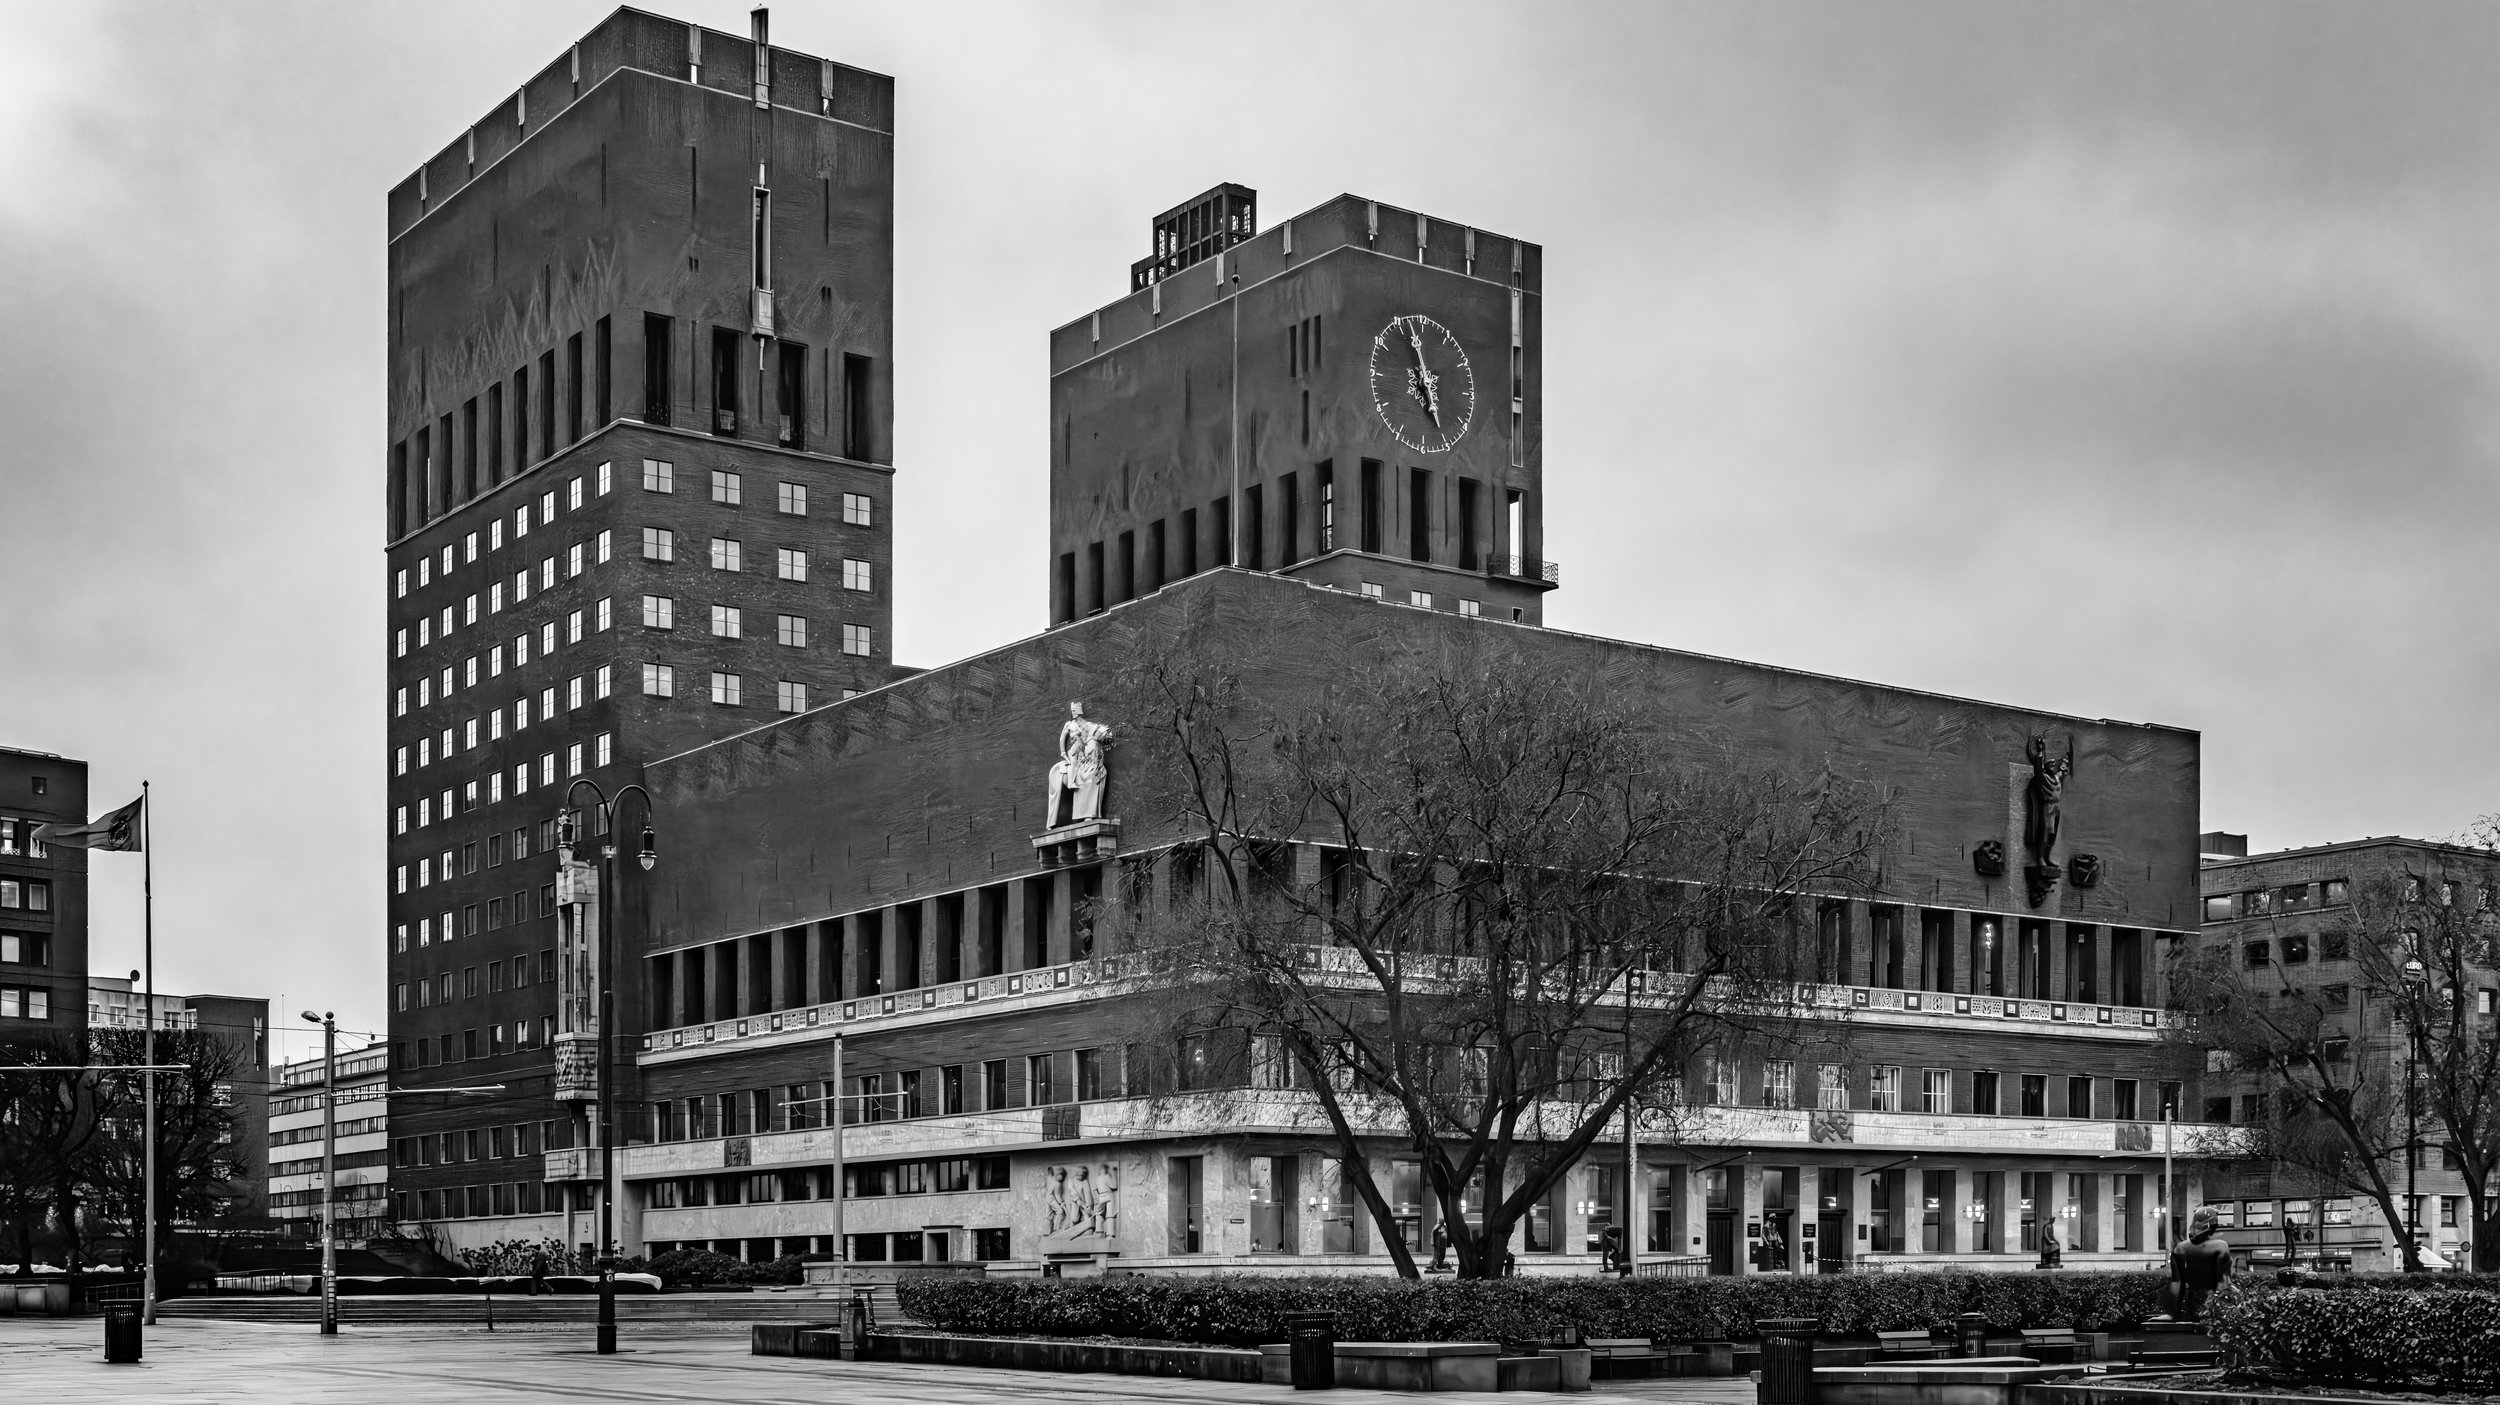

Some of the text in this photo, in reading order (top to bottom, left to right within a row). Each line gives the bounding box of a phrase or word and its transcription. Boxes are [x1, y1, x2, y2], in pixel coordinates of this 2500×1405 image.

[1393, 316, 1401, 326] 11
[1419, 314, 1427, 325] 12
[1446, 329, 1451, 339] 1
[1374, 335, 1384, 346] 10
[1463, 357, 1469, 367] 2
[1369, 368, 1376, 377] 9
[1469, 390, 1475, 400] 3
[1376, 403, 1382, 413] 8
[1462, 422, 1468, 432] 4
[1394, 431, 1401, 440] 7
[1420, 445, 1426, 455] 6
[1445, 442, 1451, 452] 5
